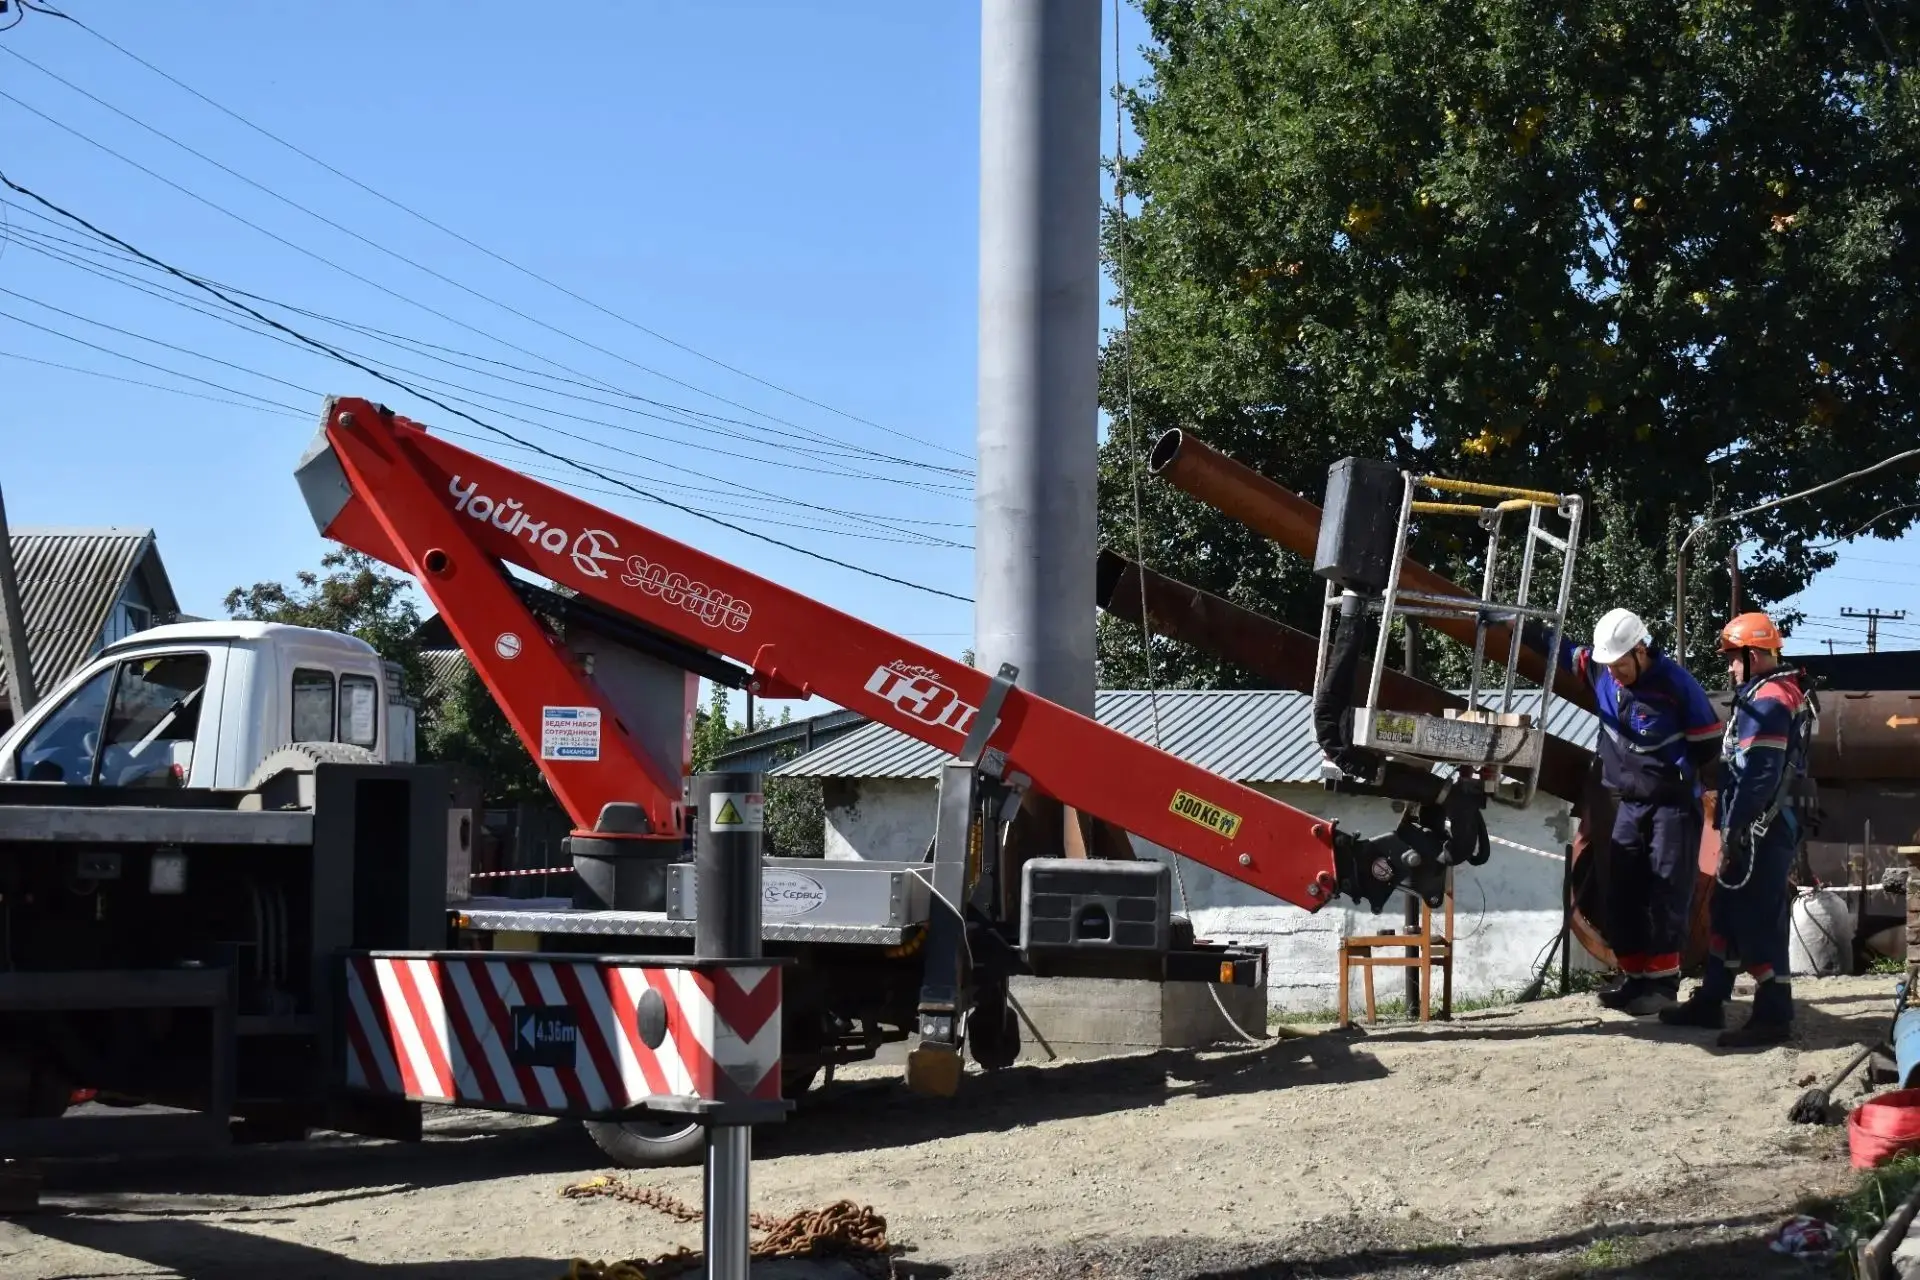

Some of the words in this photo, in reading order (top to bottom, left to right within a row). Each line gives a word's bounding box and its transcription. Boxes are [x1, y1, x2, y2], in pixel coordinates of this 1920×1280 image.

[449, 475, 567, 555] Чайка
[621, 555, 752, 633] socage
[545, 720, 570, 728] ВЕДЕМ
[536, 1020, 575, 1042] 4.36m
